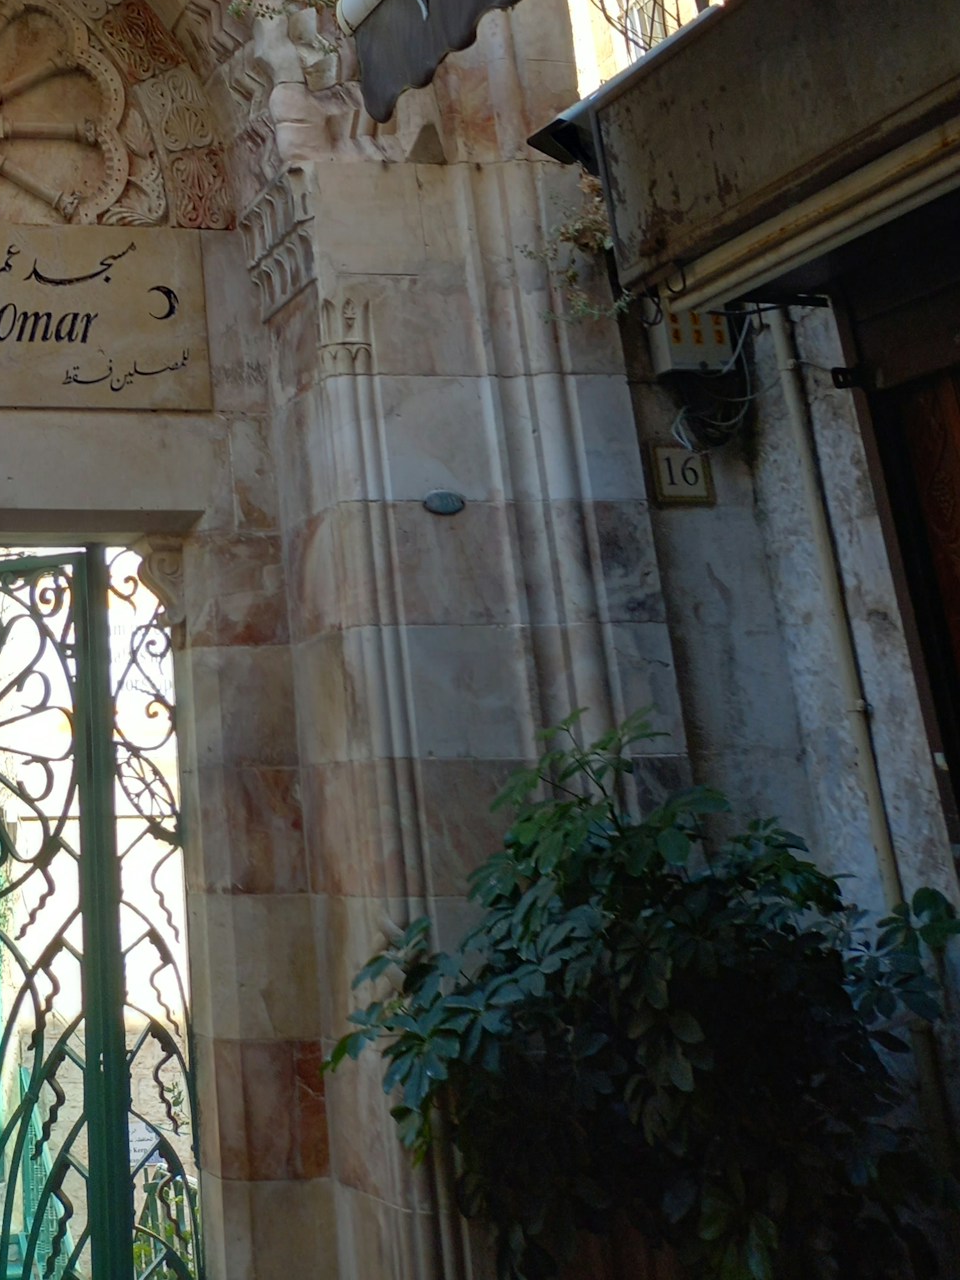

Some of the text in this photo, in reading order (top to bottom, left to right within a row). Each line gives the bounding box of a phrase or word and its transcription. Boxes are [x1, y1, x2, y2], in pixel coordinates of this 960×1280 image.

[24, 242, 137, 286] مسجد
[62, 358, 113, 385] فقط
[664, 456, 700, 487] 16
